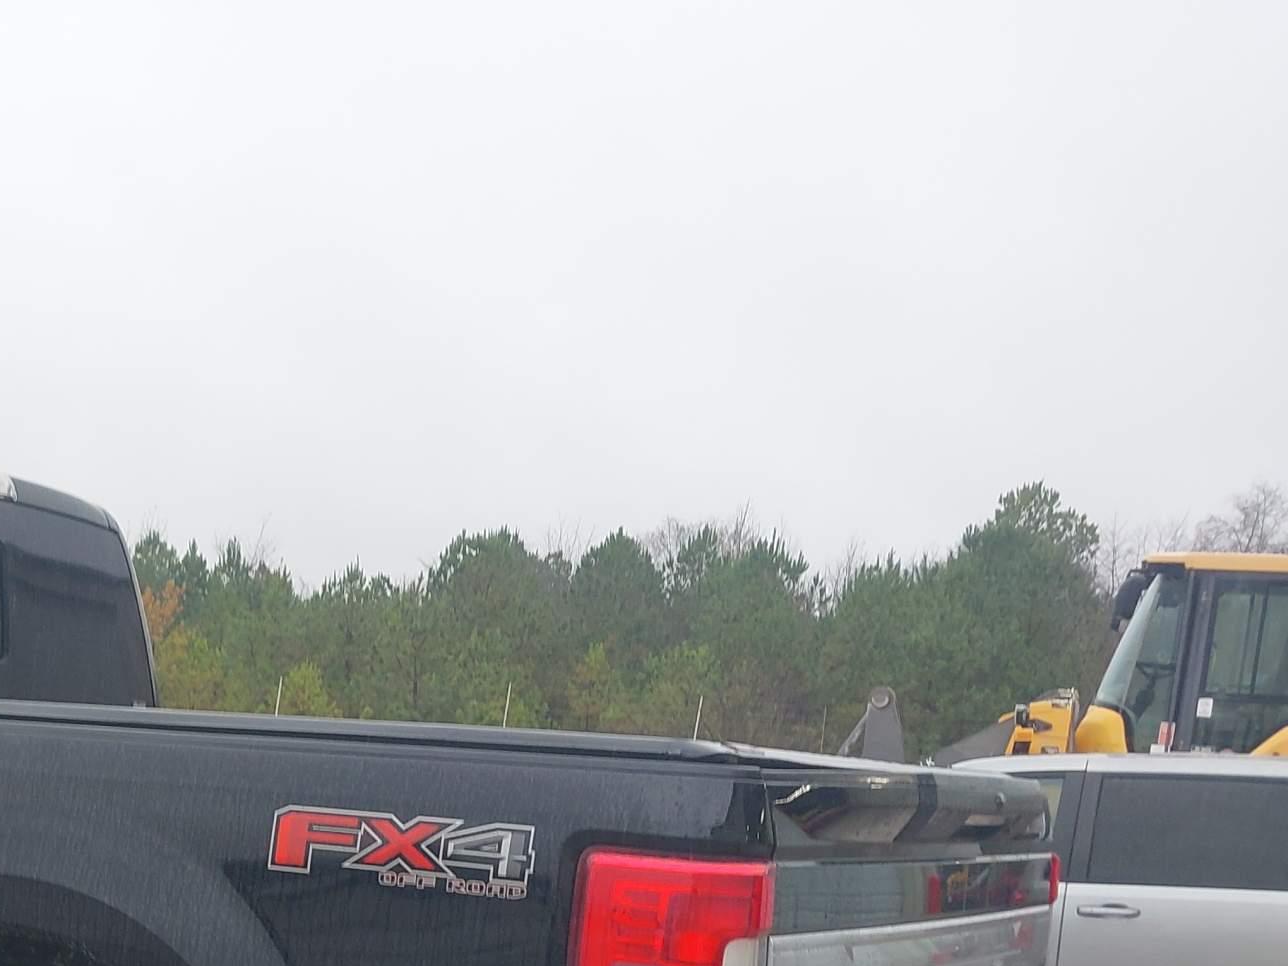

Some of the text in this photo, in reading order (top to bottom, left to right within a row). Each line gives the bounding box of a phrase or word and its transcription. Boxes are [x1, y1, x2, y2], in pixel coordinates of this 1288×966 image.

[268, 804, 536, 884] FX4
[378, 872, 527, 899] OFF ROAD
